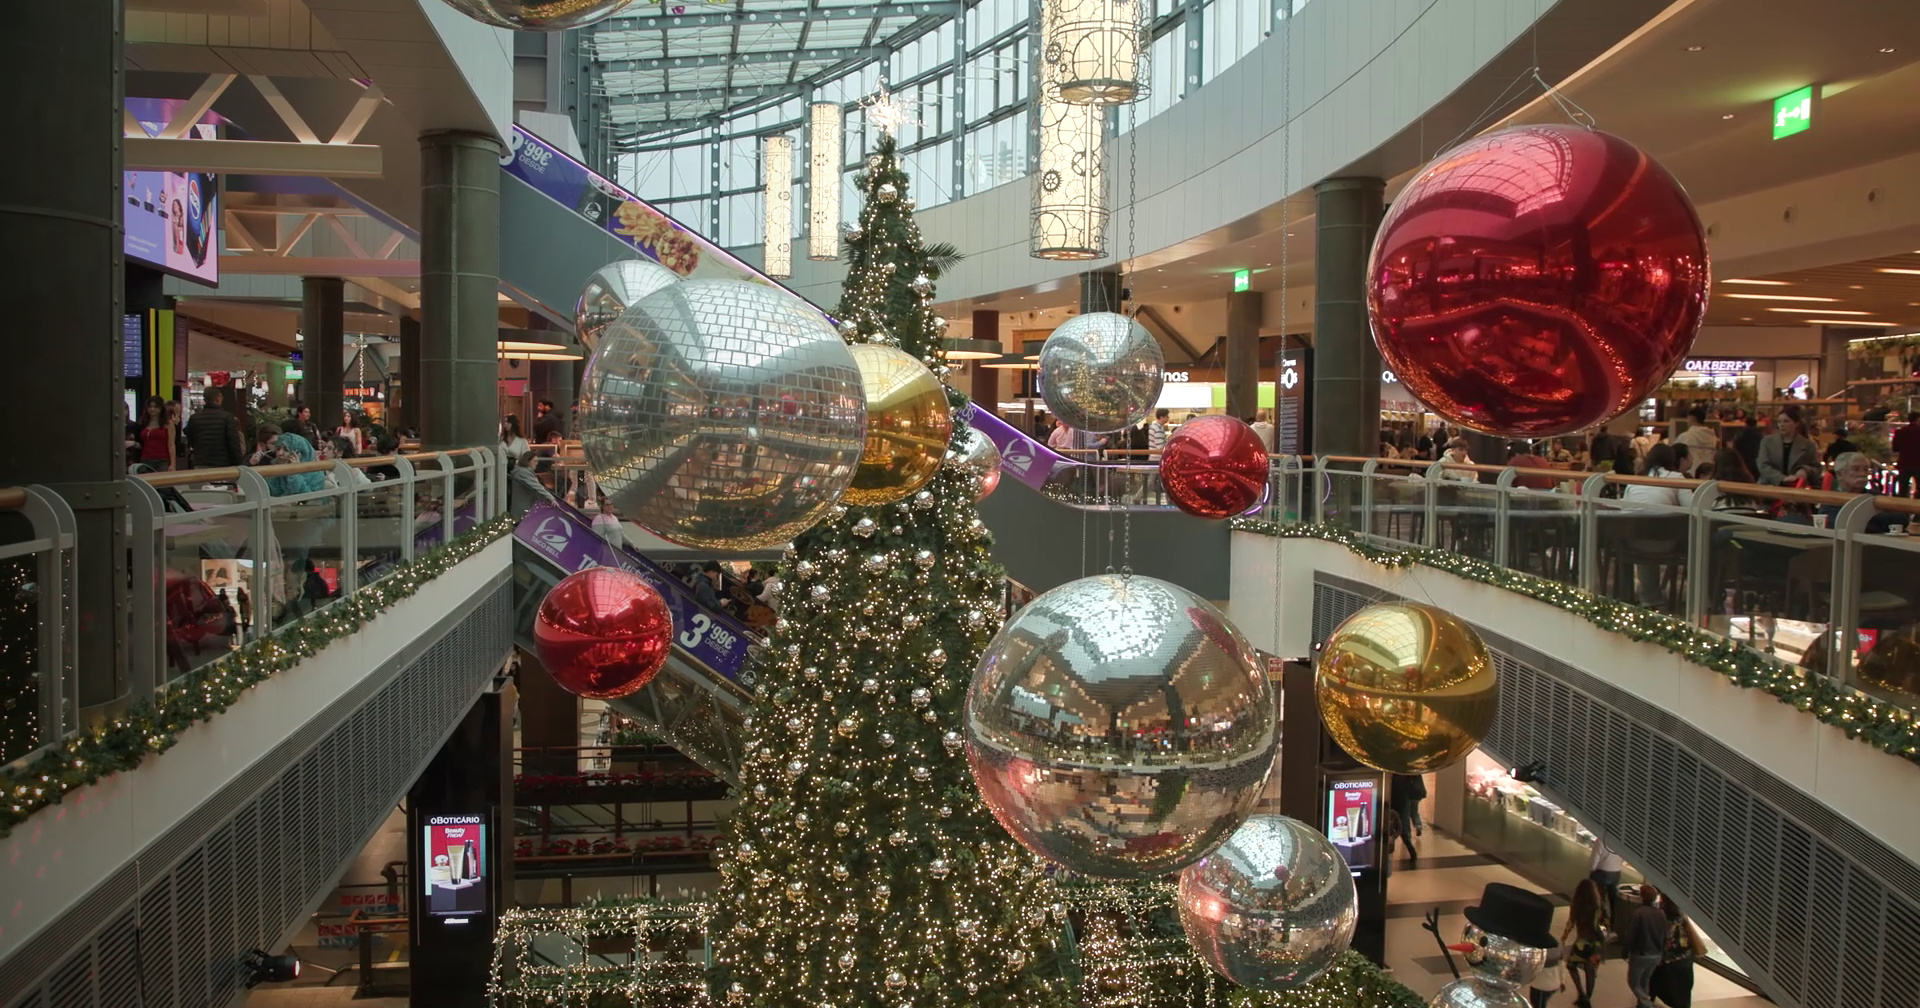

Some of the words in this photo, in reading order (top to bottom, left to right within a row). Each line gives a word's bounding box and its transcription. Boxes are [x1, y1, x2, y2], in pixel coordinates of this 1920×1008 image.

[518, 154, 546, 174] DESDE
[1161, 369, 1189, 382] nas
[531, 536, 547, 549] TACO
[545, 546, 560, 559] BELL
[704, 637, 730, 657] DESDE
